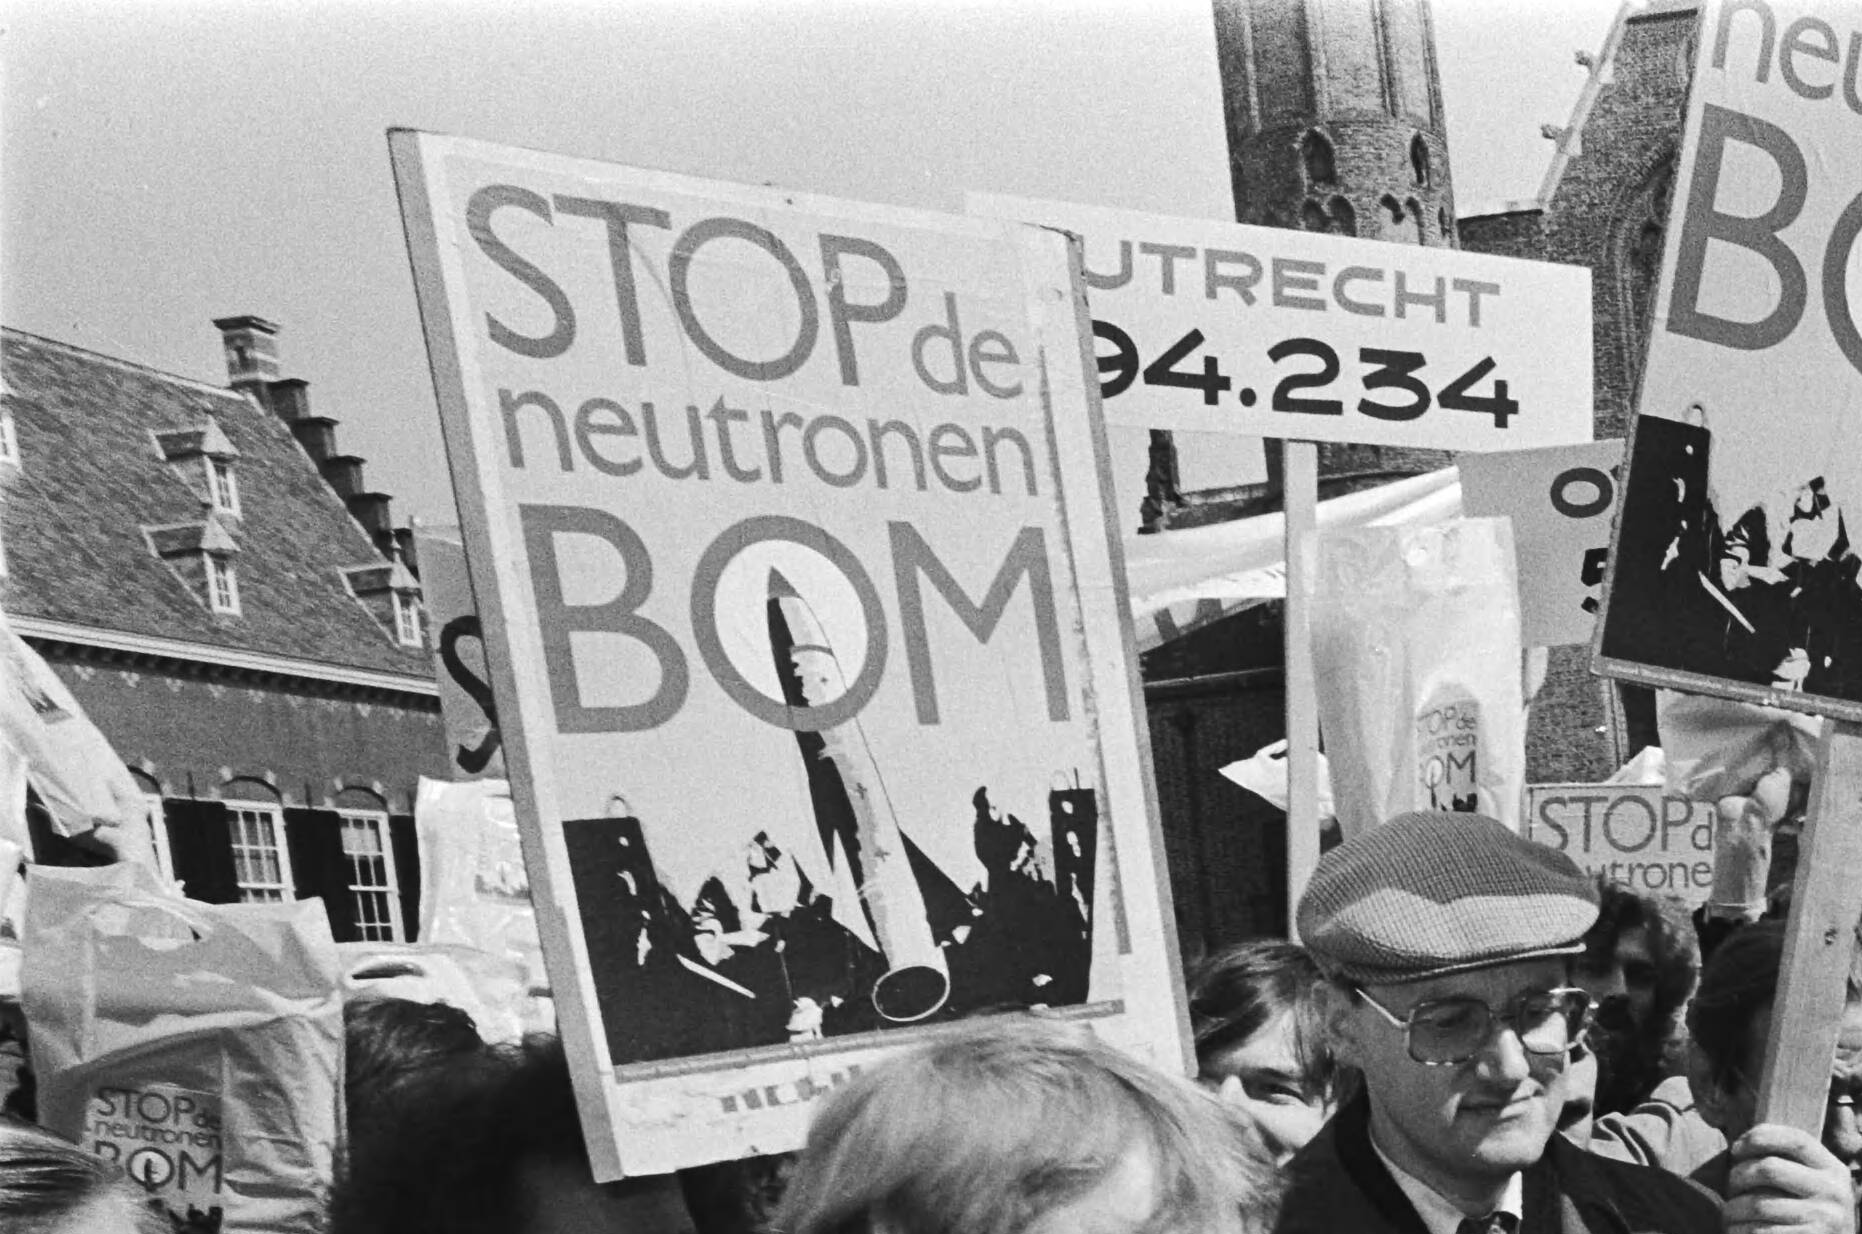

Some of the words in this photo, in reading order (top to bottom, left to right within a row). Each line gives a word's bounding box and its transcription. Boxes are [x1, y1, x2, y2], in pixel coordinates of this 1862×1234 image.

[466, 184, 908, 387] STOP
[910, 292, 1024, 399] de
[1084, 239, 1501, 328] UTRECHT
[498, 387, 1039, 497] neutronen
[518, 503, 1071, 734] BOM
[1539, 795, 1694, 852] STOP
[97, 1088, 196, 1125] STOP
